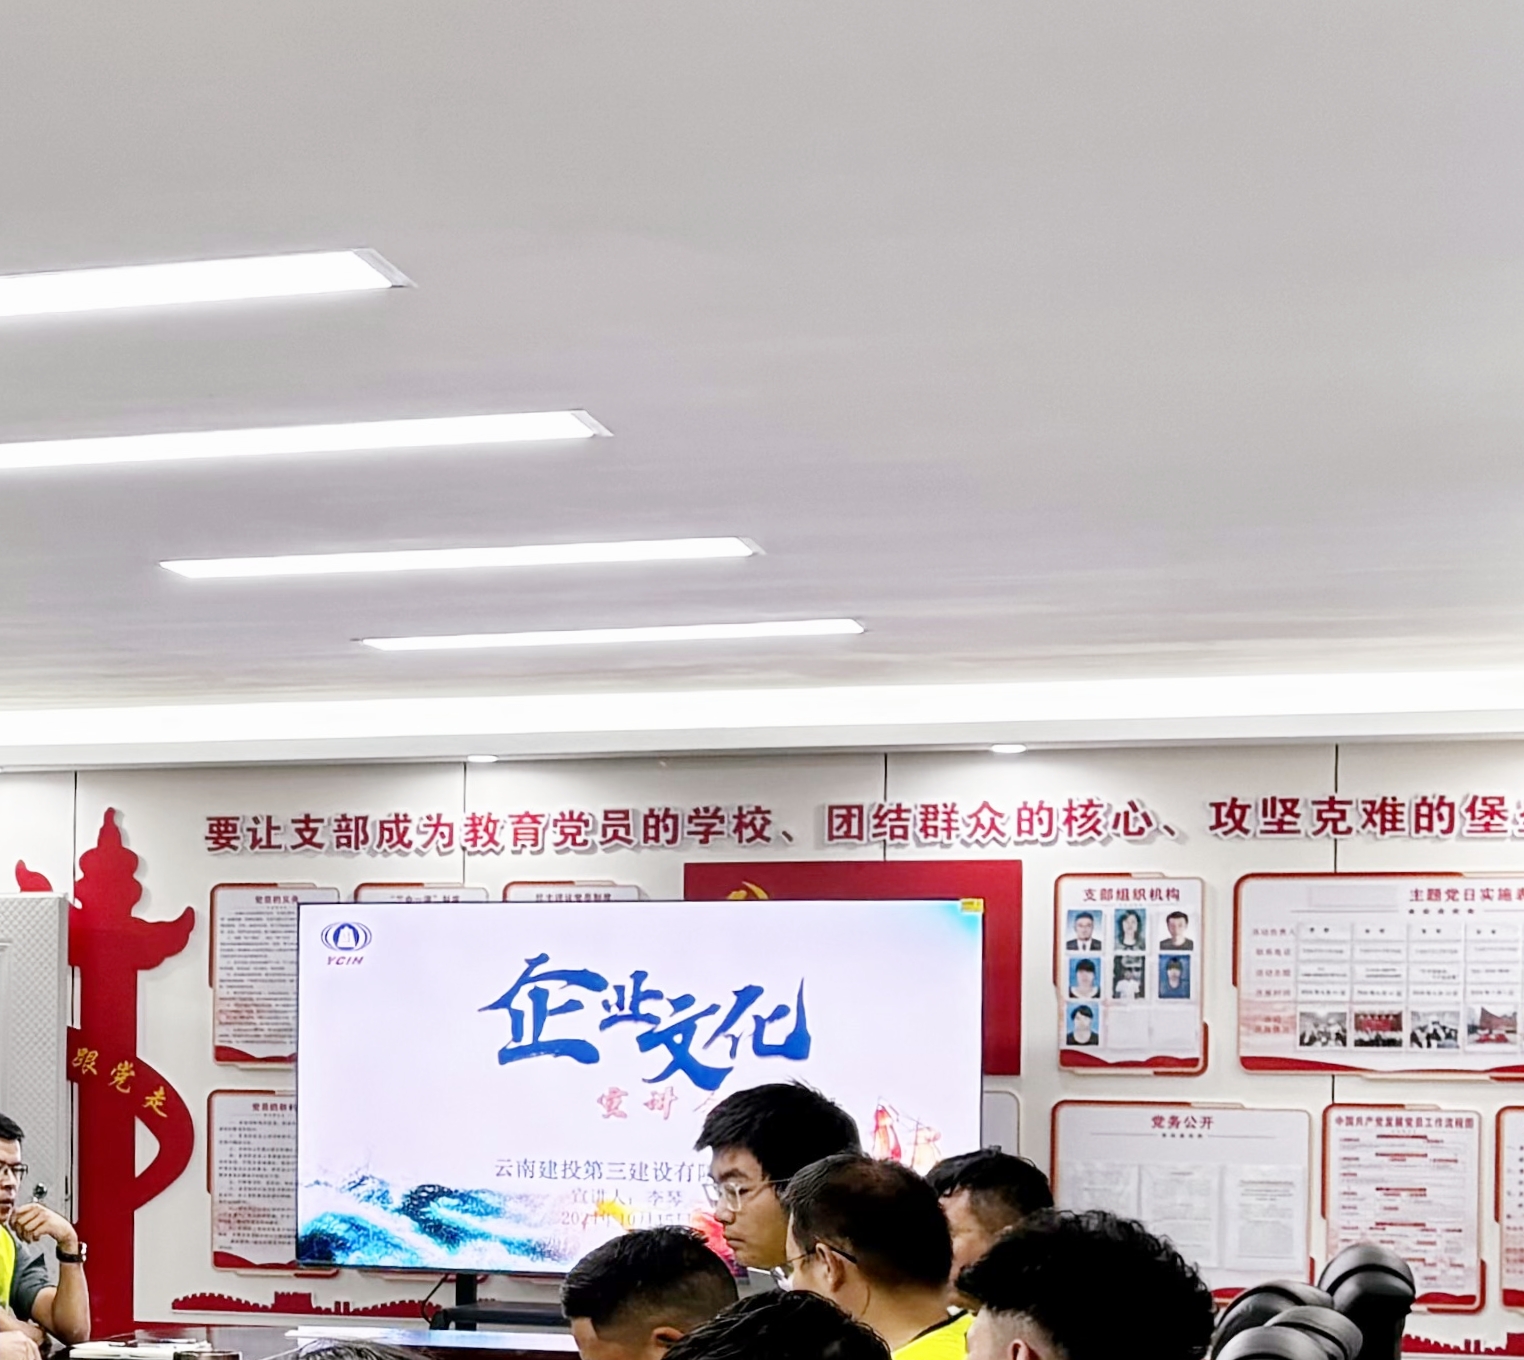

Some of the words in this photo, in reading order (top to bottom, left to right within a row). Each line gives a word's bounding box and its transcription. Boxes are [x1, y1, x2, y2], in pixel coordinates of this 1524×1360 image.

[1083, 887, 1181, 902] 支部组织机构
[478, 952, 812, 1092] 企业文化
[72, 1047, 168, 1118] 跟党走
[1151, 1115, 1215, 1130] 党务公开
